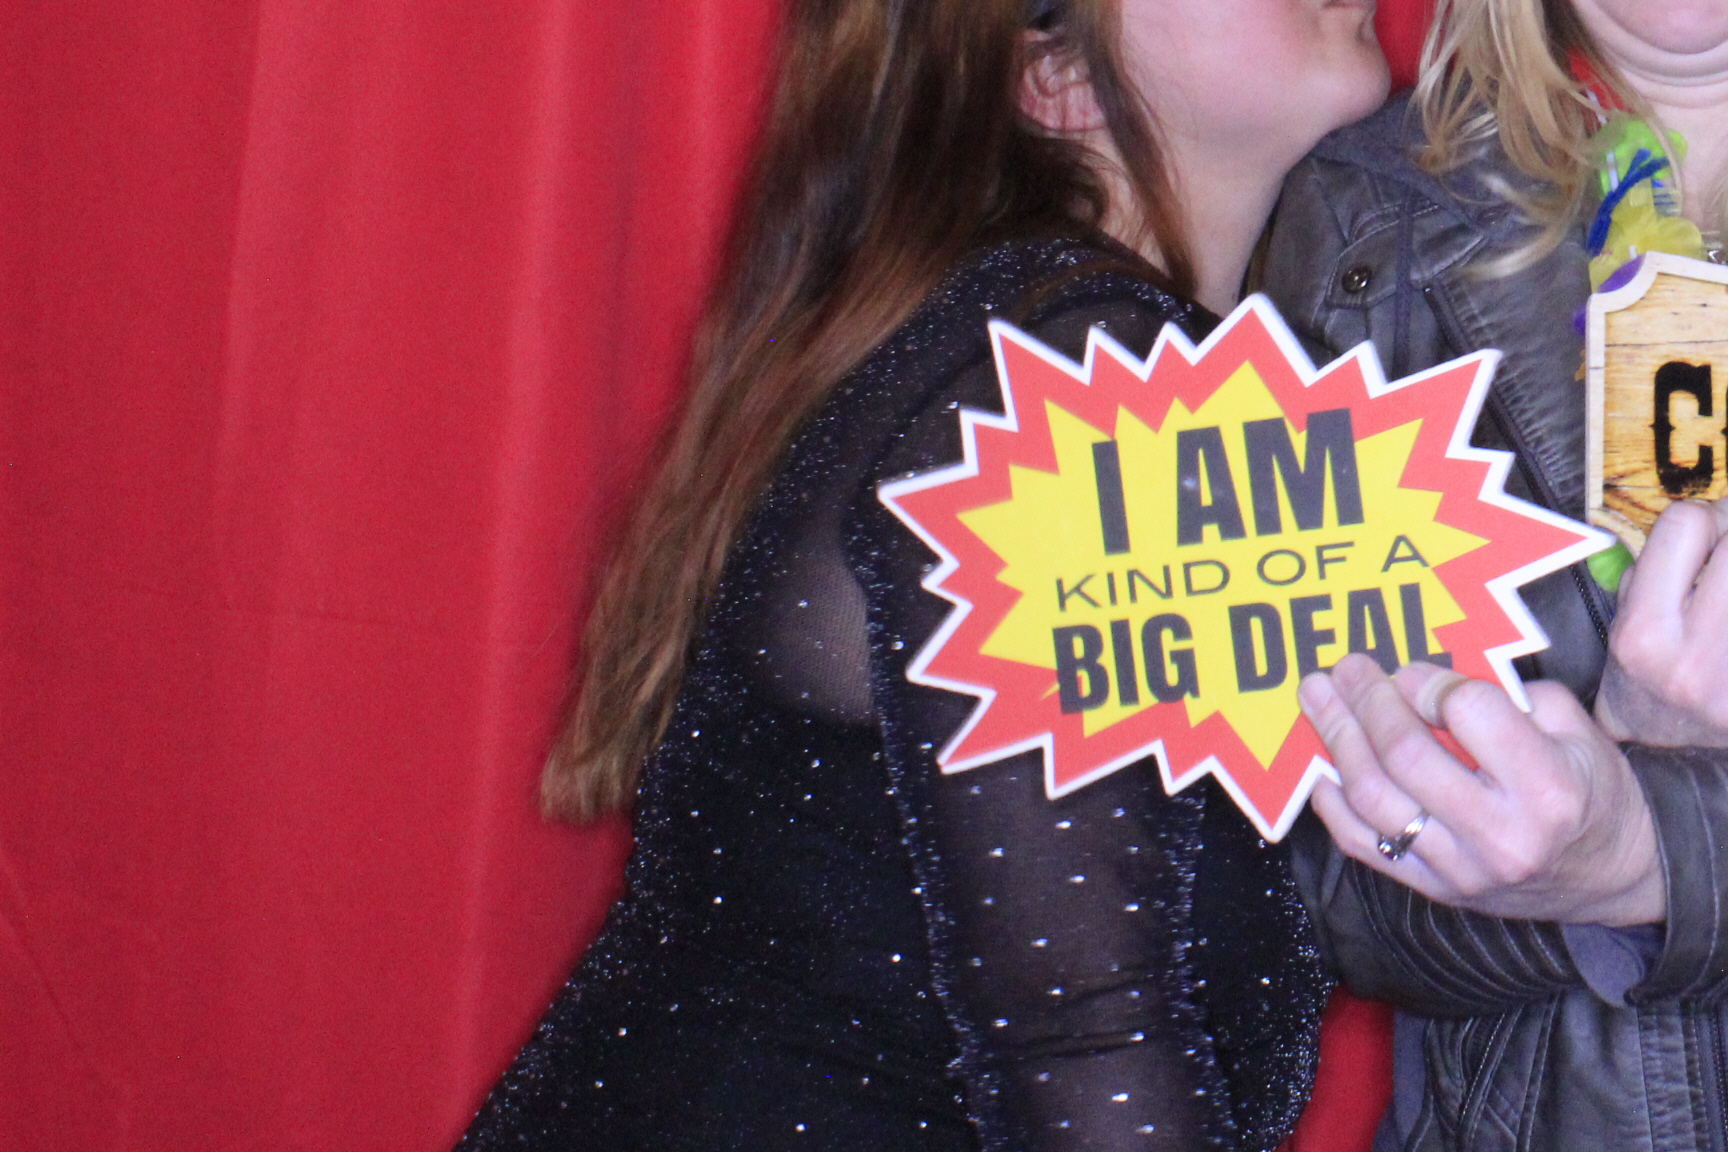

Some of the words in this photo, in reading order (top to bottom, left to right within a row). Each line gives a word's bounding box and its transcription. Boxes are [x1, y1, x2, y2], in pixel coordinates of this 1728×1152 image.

[1091, 440, 1131, 557] I
[1176, 407, 1365, 548] AM
[1056, 558, 1230, 612] KIND
[1256, 541, 1355, 588] OF
[1380, 534, 1431, 573] A
[1052, 612, 1200, 715] BIG
[1228, 582, 1453, 695] DEAL
